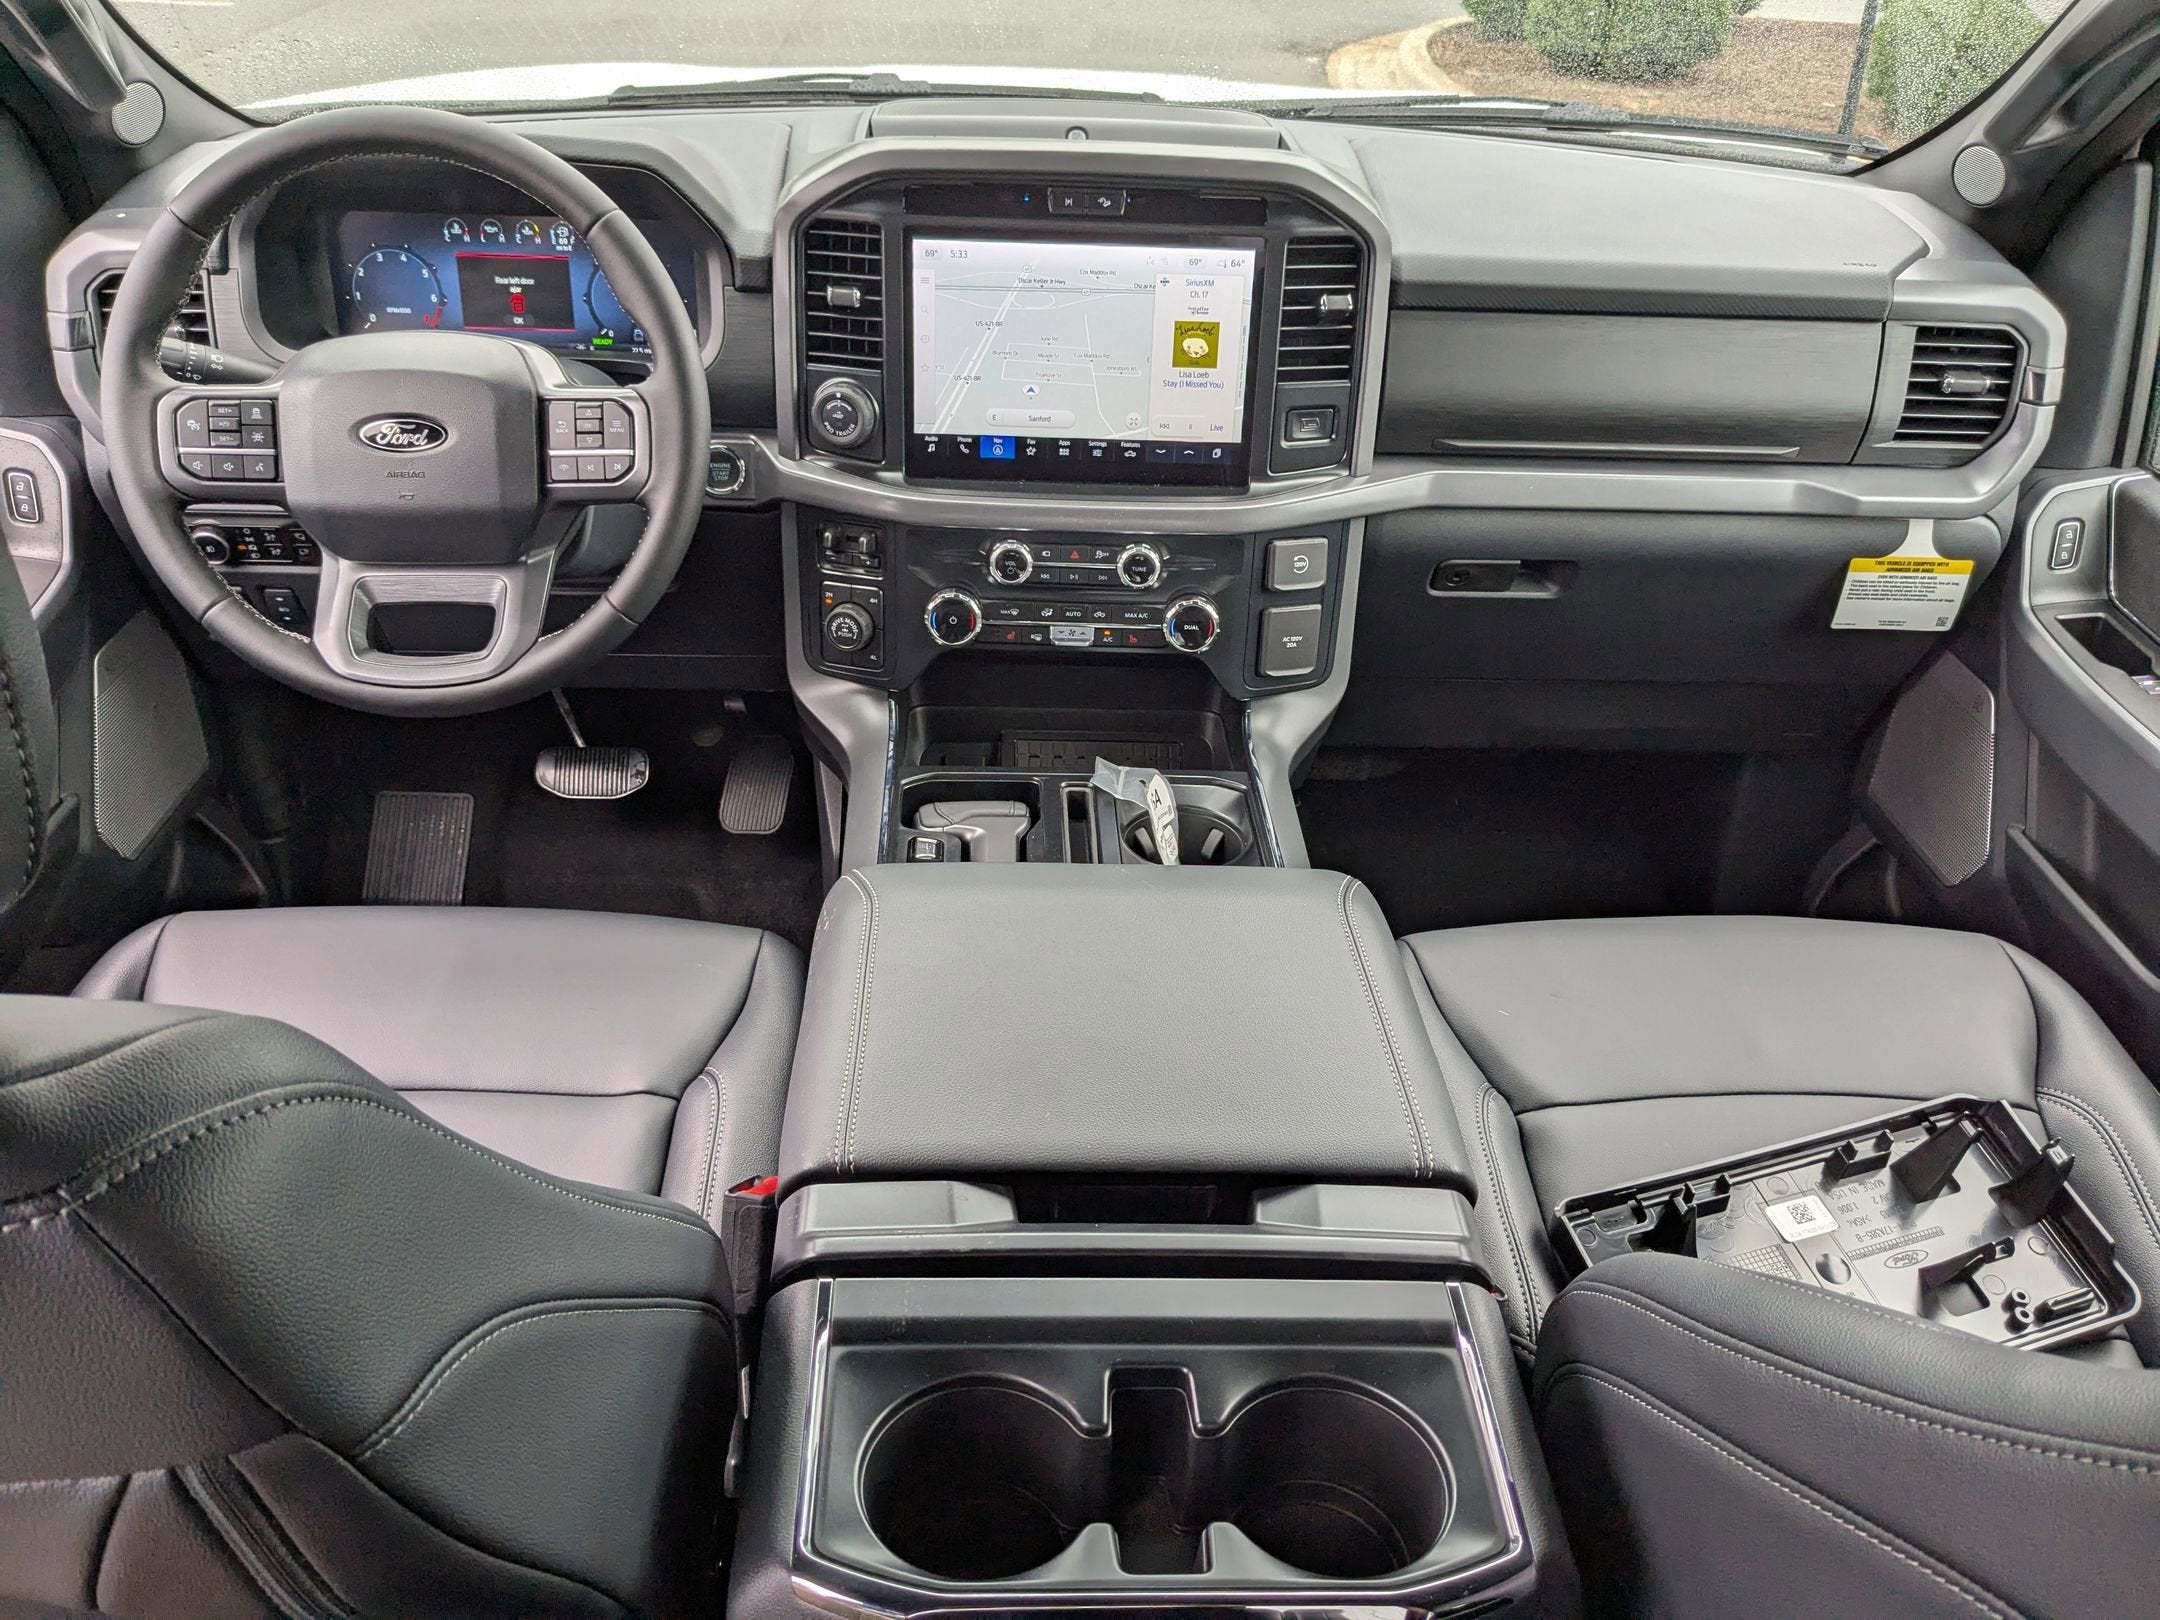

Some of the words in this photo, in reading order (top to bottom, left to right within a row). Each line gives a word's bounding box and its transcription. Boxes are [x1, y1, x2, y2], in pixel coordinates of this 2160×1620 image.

[376, 253, 383, 262] 3
[400, 253, 407, 262] 4
[925, 249, 938, 257] 69°
[950, 250, 968, 259] 5:33
[1189, 258, 1202, 266] 69°
[1231, 259, 1245, 268] 64°
[358, 268, 364, 276] 2
[422, 269, 429, 278] 5
[520, 277, 535, 285] door
[1185, 278, 1215, 287] SiriusXM
[431, 294, 438, 302] 6
[1190, 290, 1200, 298] Ch.
[1202, 290, 1209, 298] 17
[370, 313, 376, 322] 0
[608, 329, 614, 337] 0
[1179, 370, 1192, 378] Lisa
[1193, 371, 1210, 379] Loeb
[1162, 380, 1178, 388] Stay
[1185, 380, 1208, 388] Missed
[1209, 381, 1224, 389] You)
[1028, 415, 1051, 423] Sanford
[824, 421, 835, 434] PRO
[835, 423, 856, 437] TRAILER
[1210, 424, 1224, 432] Live
[376, 422, 430, 446] Ford
[831, 617, 844, 631] DRIVE
[845, 617, 859, 633] MODE
[1861, 1178, 1885, 1192] MADE
[1829, 1189, 1847, 1201] USA
[1848, 1185, 1860, 1196] IN
[1838, 1202, 1859, 1215] 1.006
[1846, 1214, 1872, 1227] >ASA<
[1893, 1251, 1919, 1266] Ford
